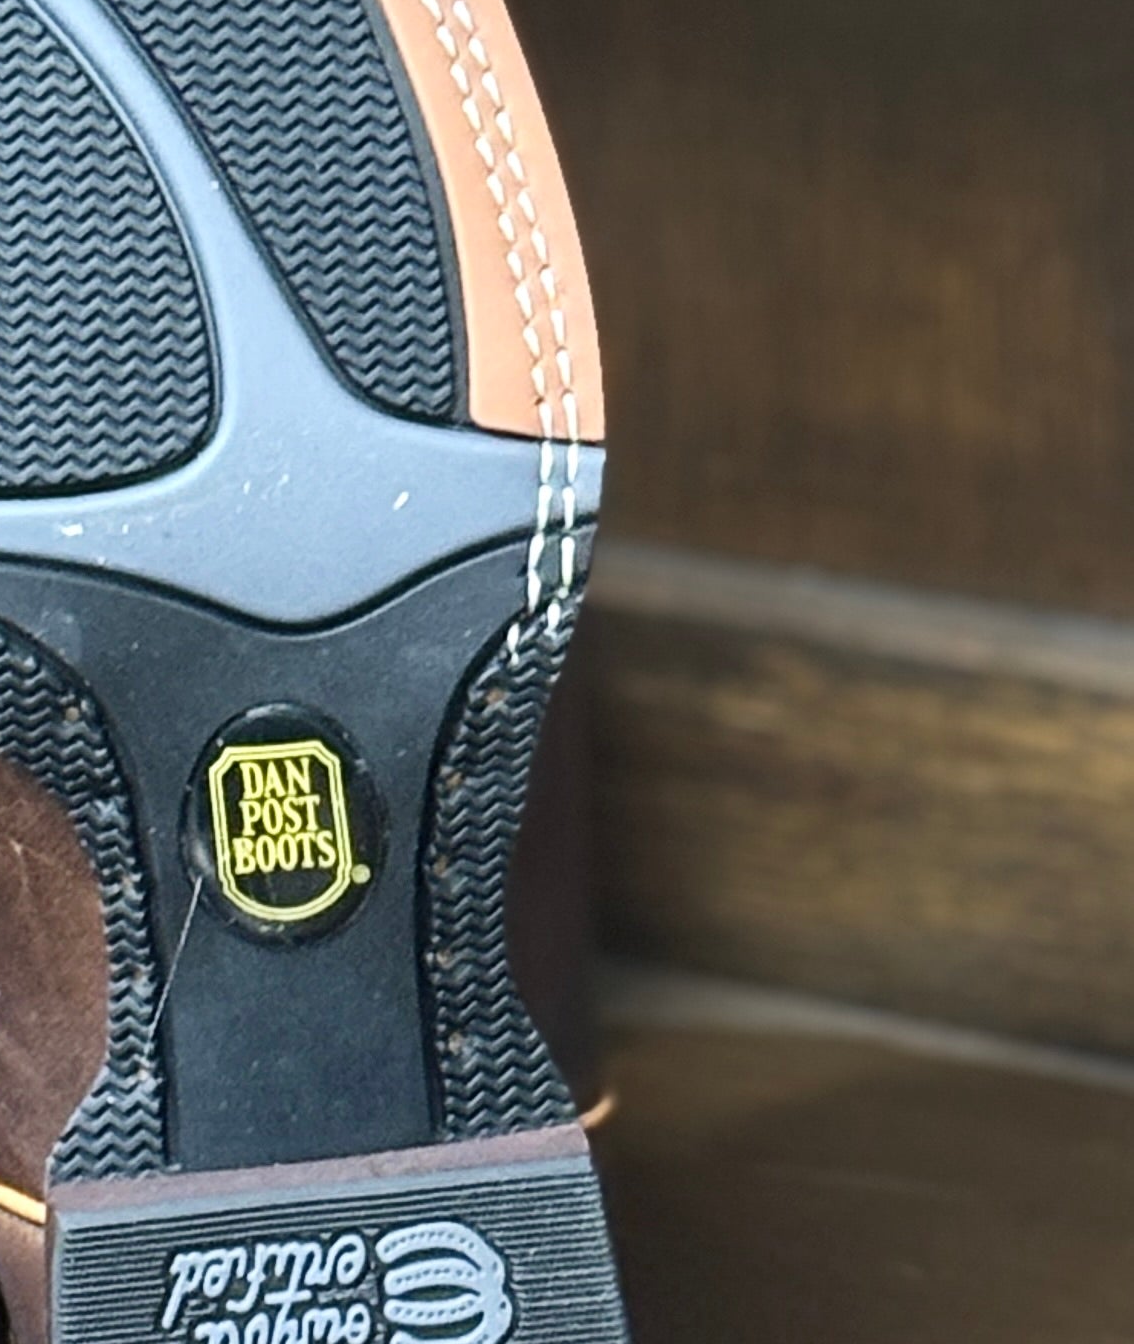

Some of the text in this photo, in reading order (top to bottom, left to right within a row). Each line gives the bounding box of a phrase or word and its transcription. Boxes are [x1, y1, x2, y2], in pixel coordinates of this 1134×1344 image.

[240, 757, 312, 799] DAN
[240, 795, 320, 836] POST
[232, 831, 337, 874] BOOTS
